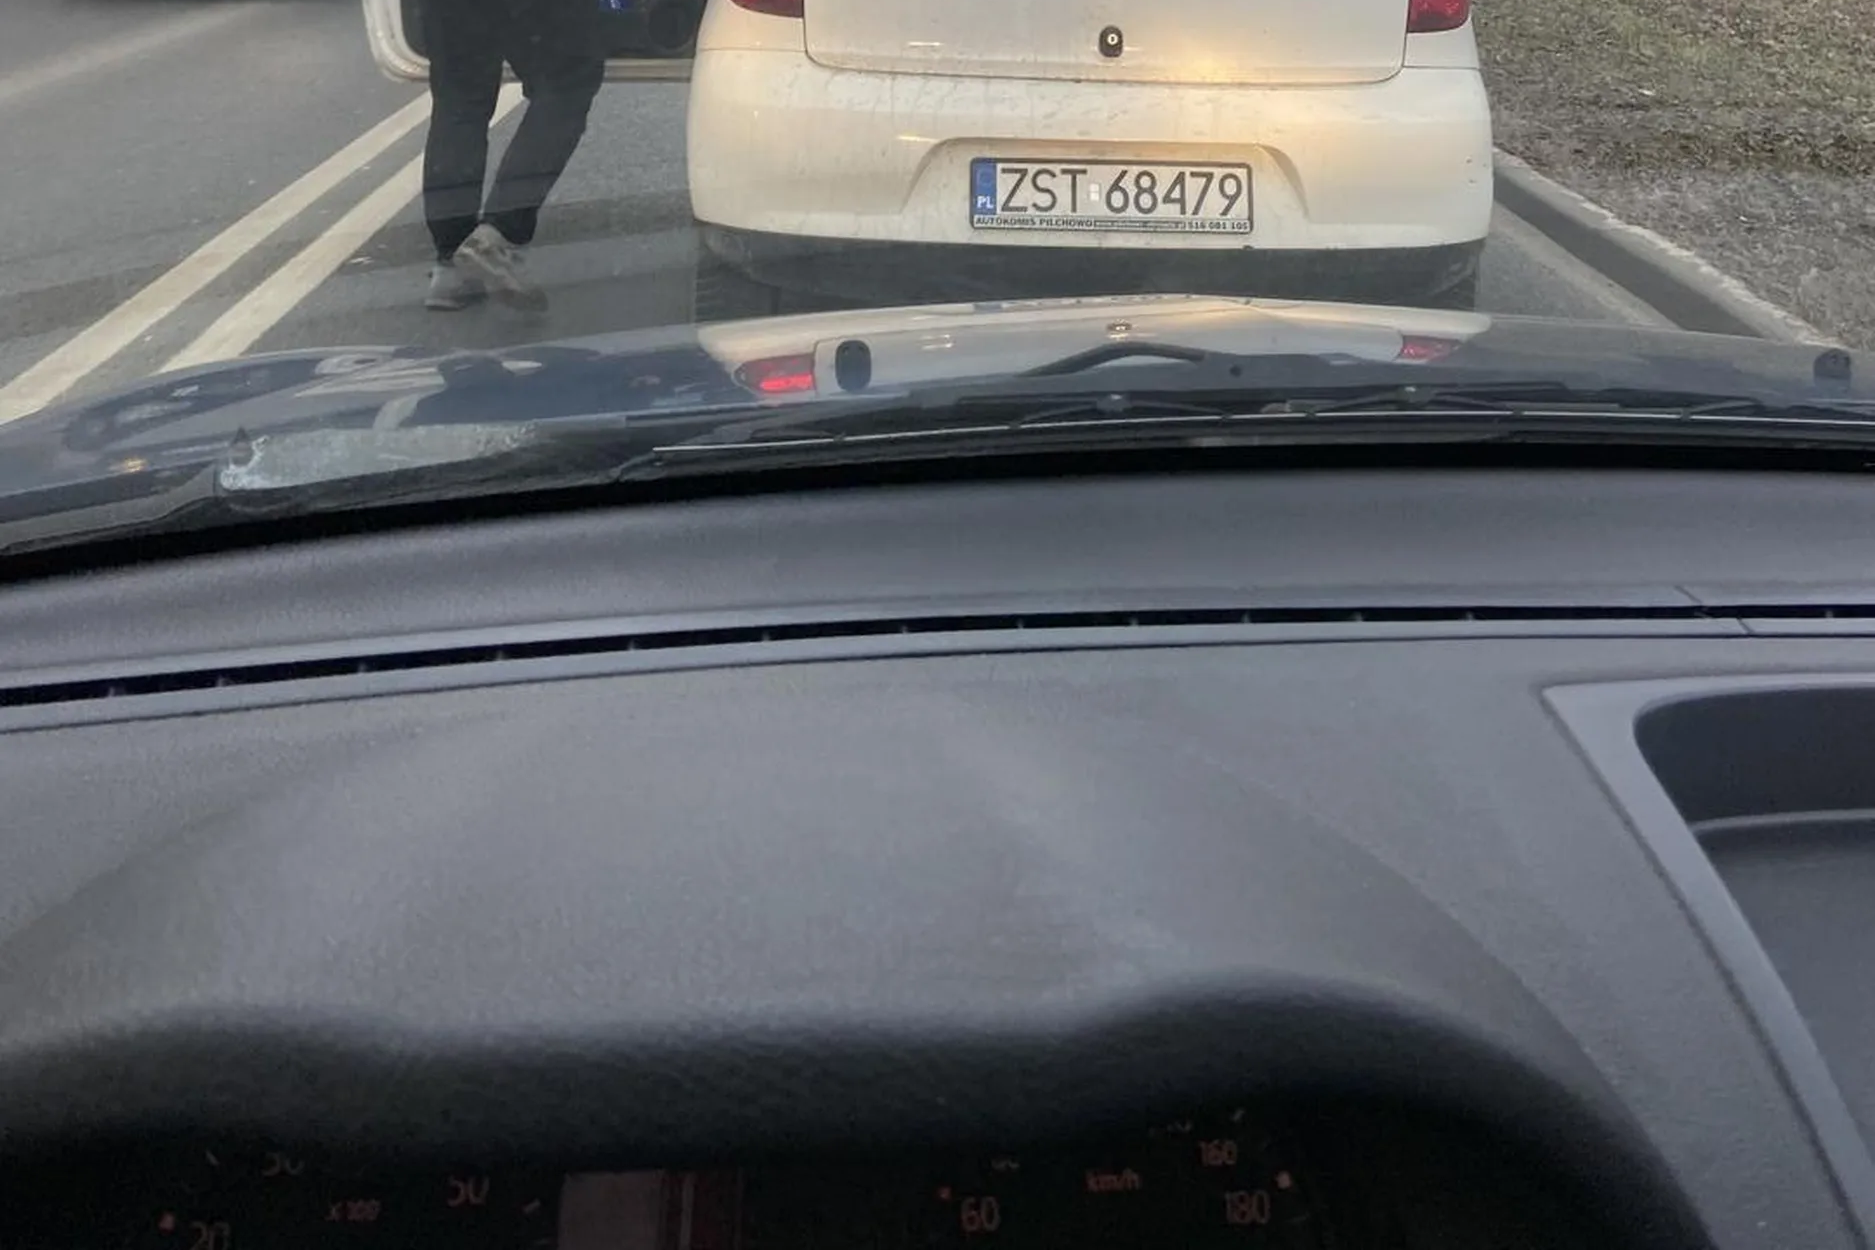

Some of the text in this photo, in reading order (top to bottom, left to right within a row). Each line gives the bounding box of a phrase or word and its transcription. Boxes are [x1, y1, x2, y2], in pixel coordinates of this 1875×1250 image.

[976, 195, 994, 210] PL
[1000, 167, 1244, 216] ZST 68479
[975, 217, 1036, 227] AUTOKOMIS
[1039, 218, 1093, 228] PILCHOWO
[960, 1196, 1002, 1234] 60
[1224, 1189, 1271, 1227] 180
